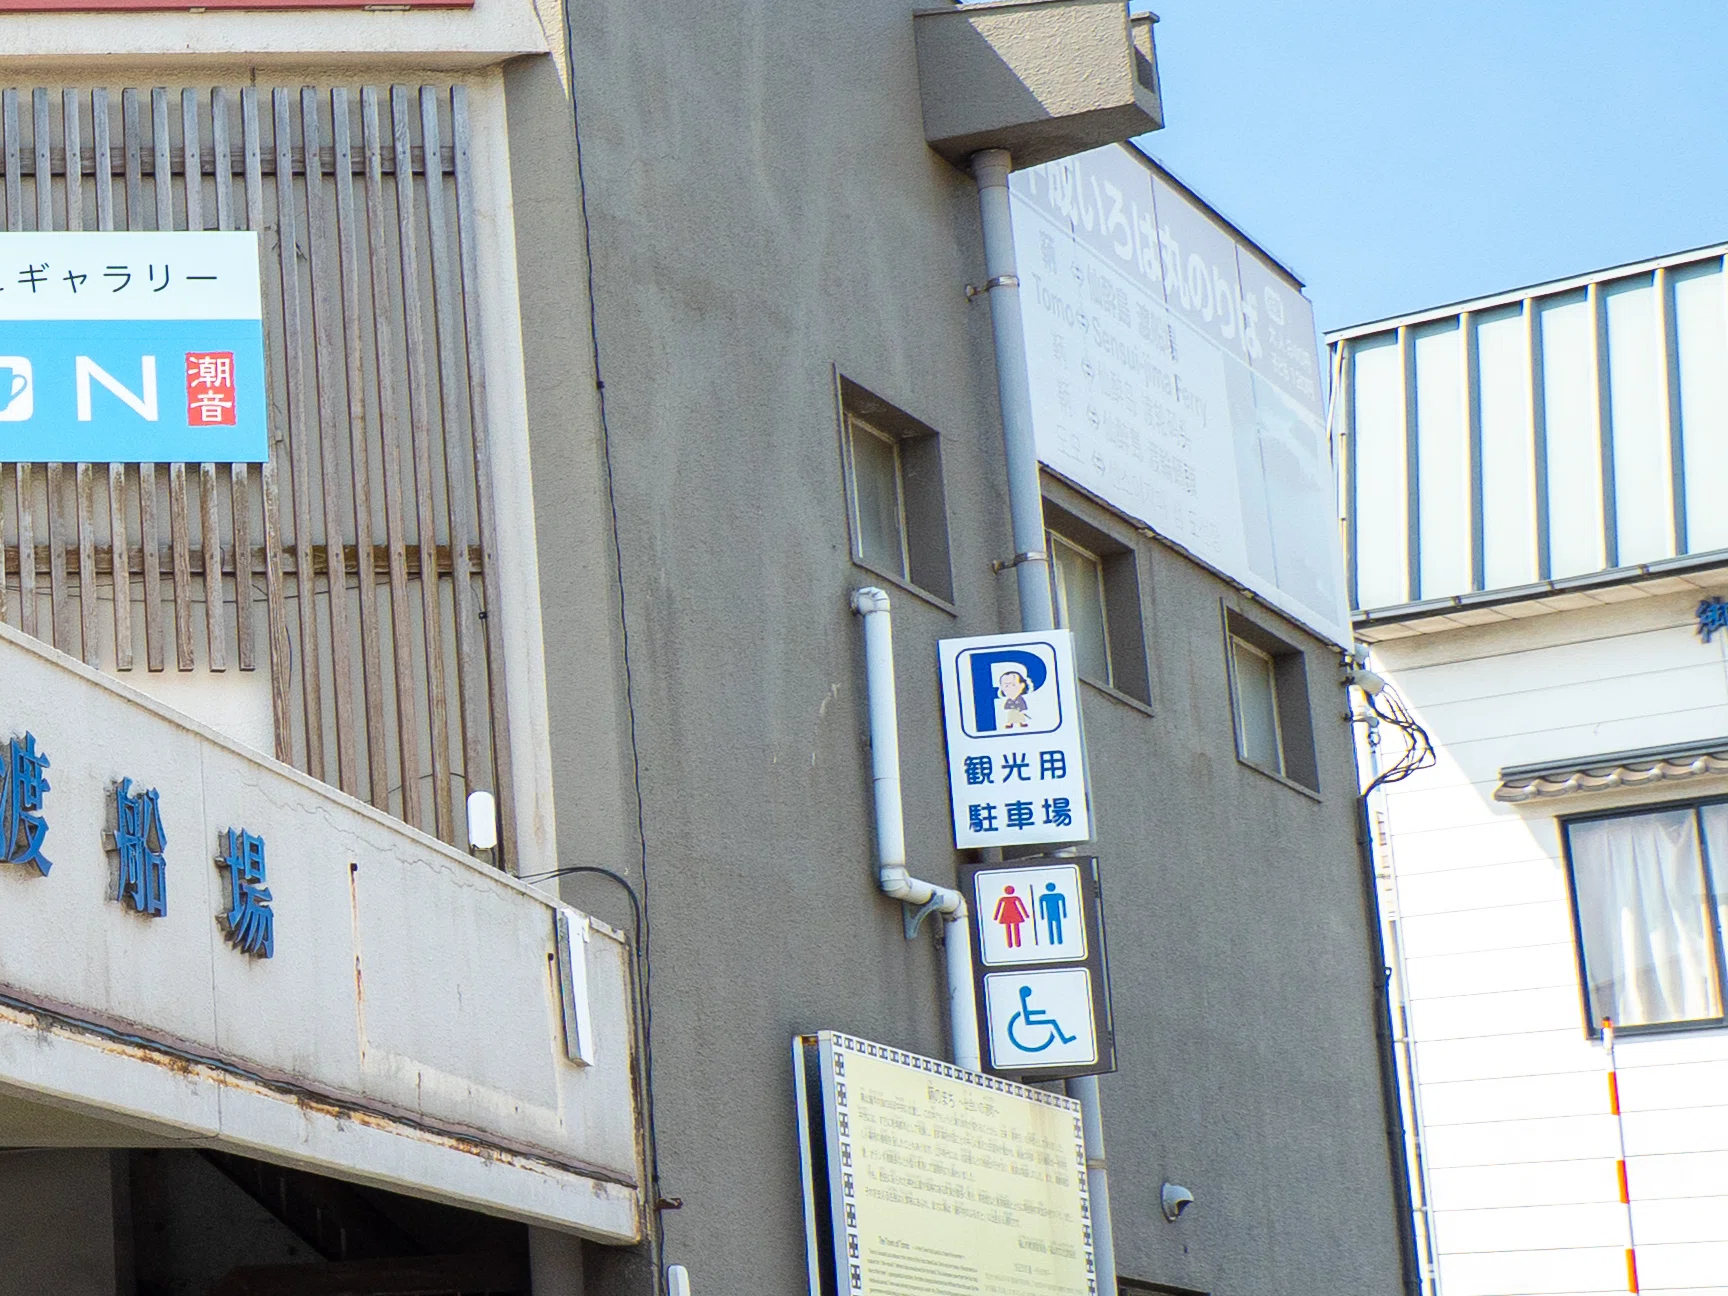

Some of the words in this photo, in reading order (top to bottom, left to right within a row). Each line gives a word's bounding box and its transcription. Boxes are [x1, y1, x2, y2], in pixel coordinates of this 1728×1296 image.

[186, 354, 234, 424] 潮音
[969, 649, 1048, 733] P
[964, 750, 1068, 786] 観光用
[968, 797, 1072, 833] 駐車場
